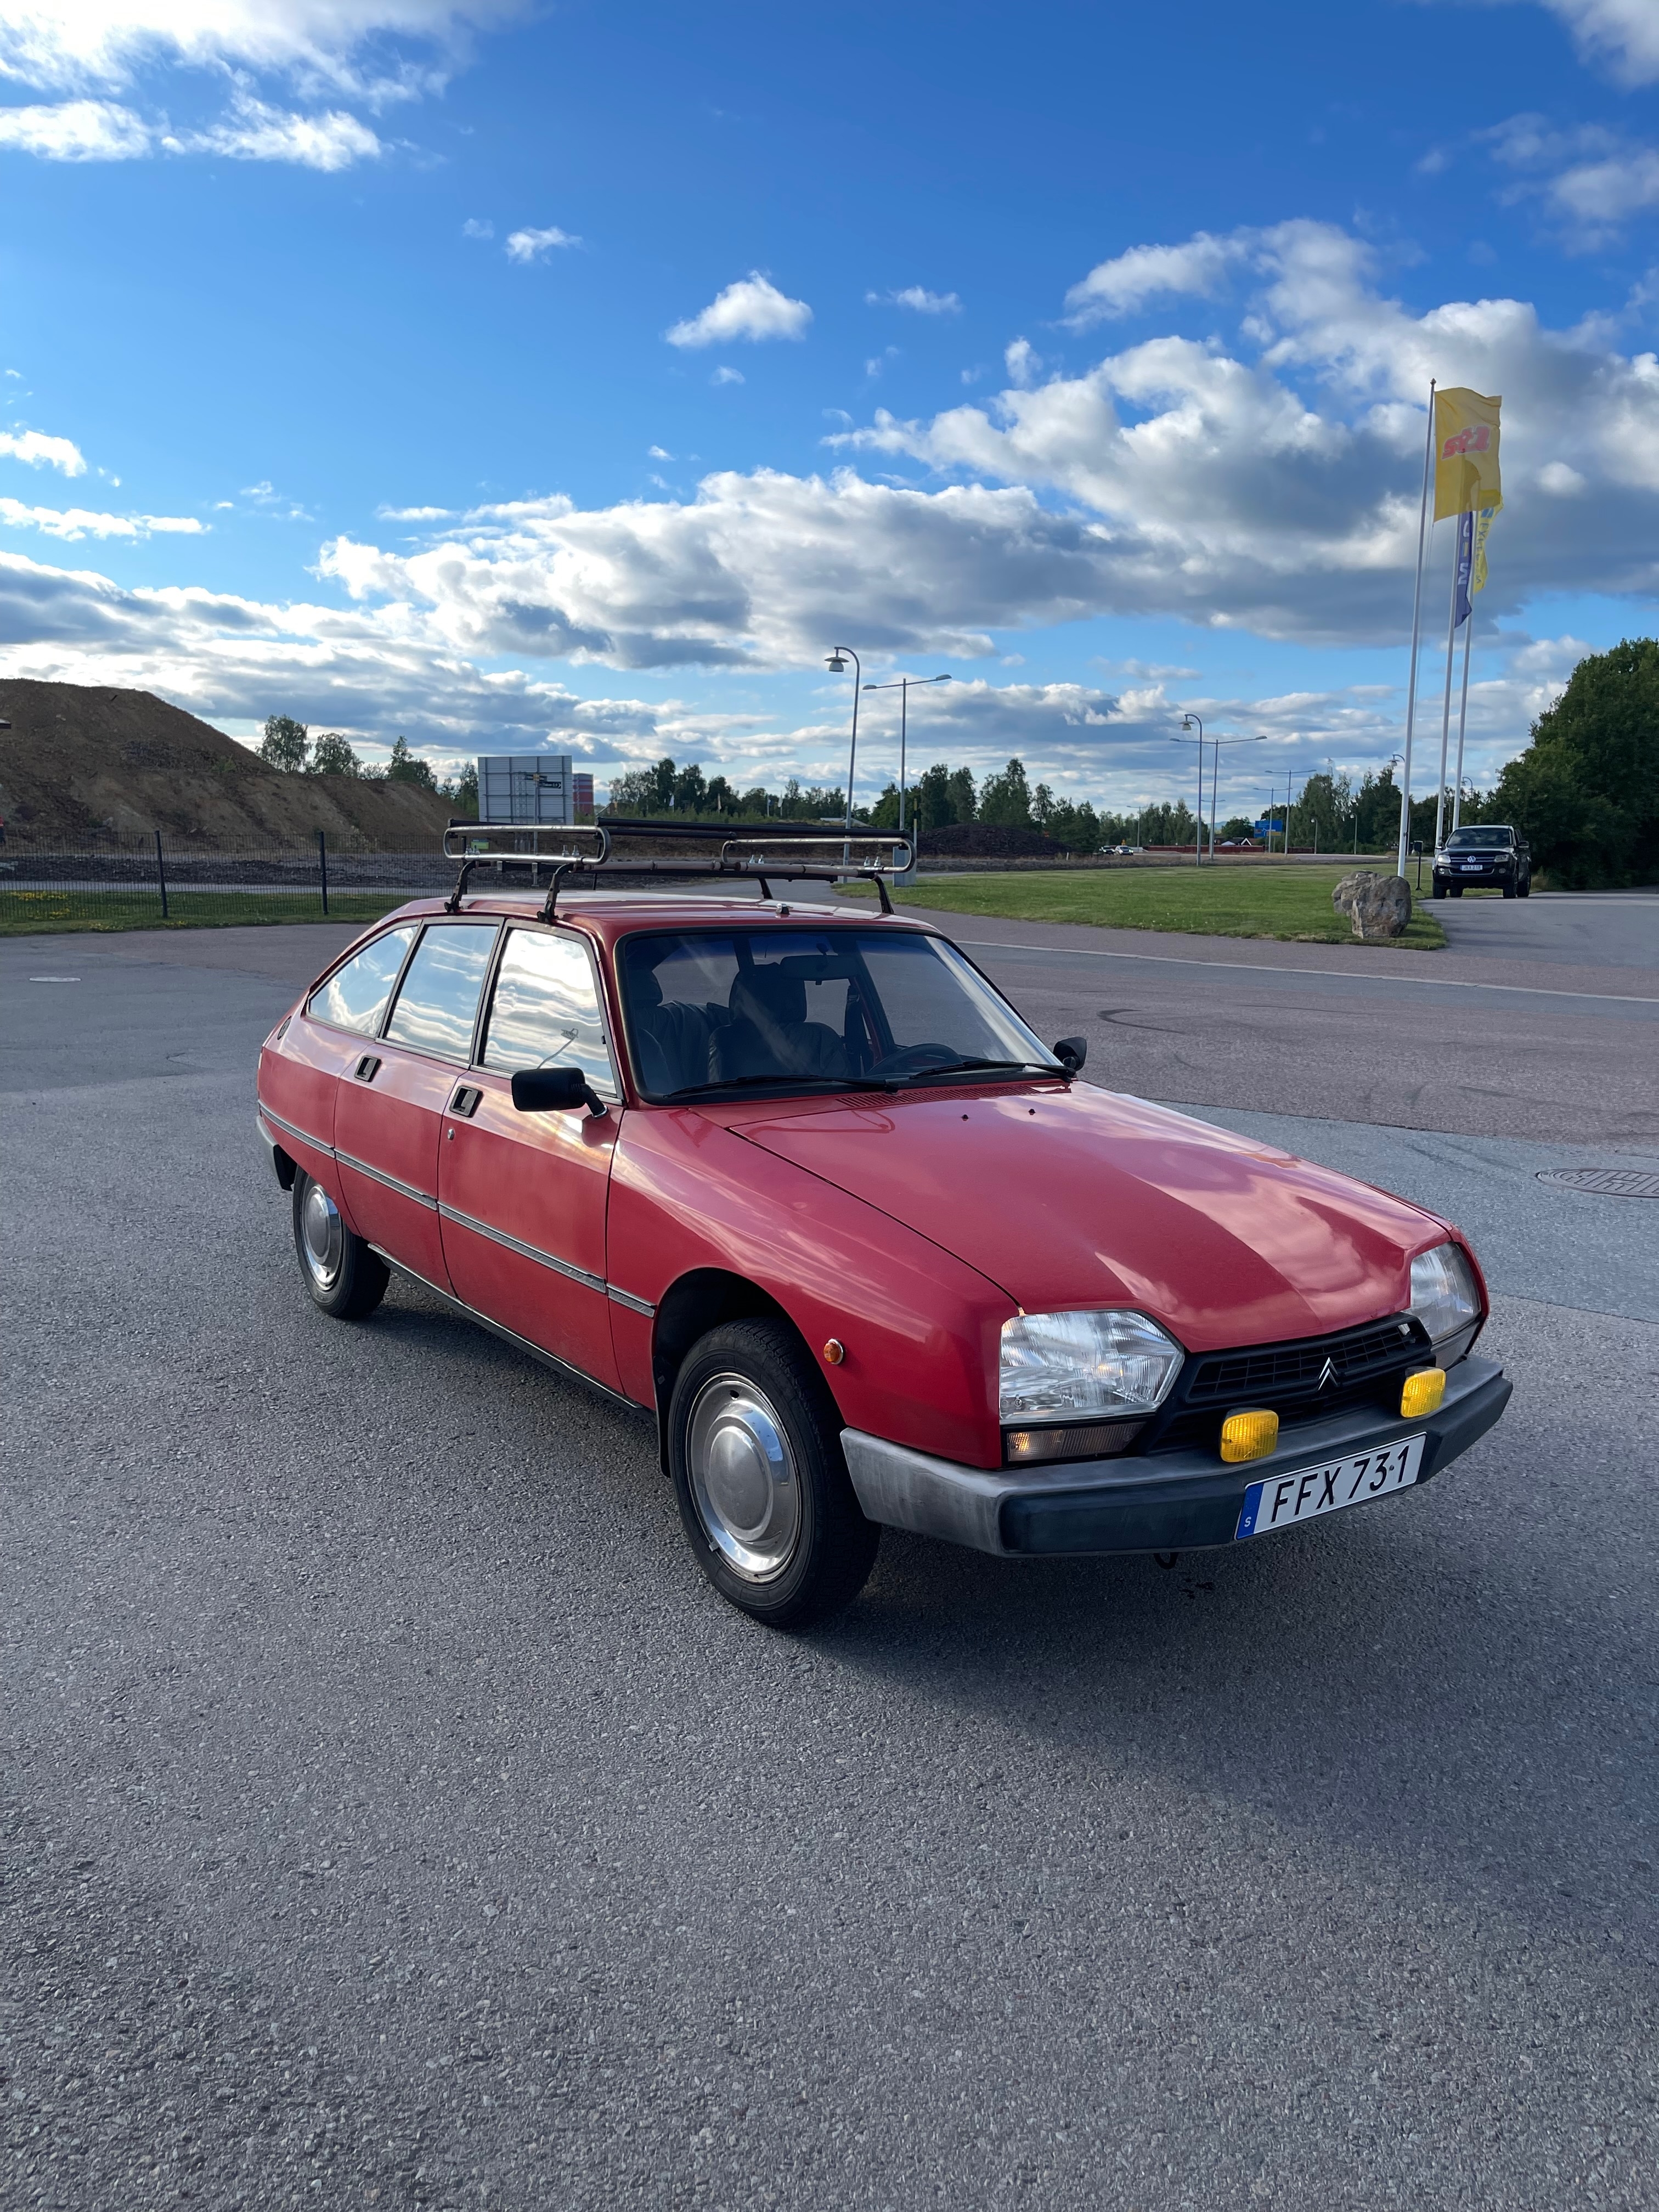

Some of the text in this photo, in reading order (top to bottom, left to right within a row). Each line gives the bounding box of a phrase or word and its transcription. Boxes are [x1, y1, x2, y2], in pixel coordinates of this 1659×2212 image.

[1270, 1444, 1409, 1523] FFX 731
[1244, 1516, 1252, 1528] S
